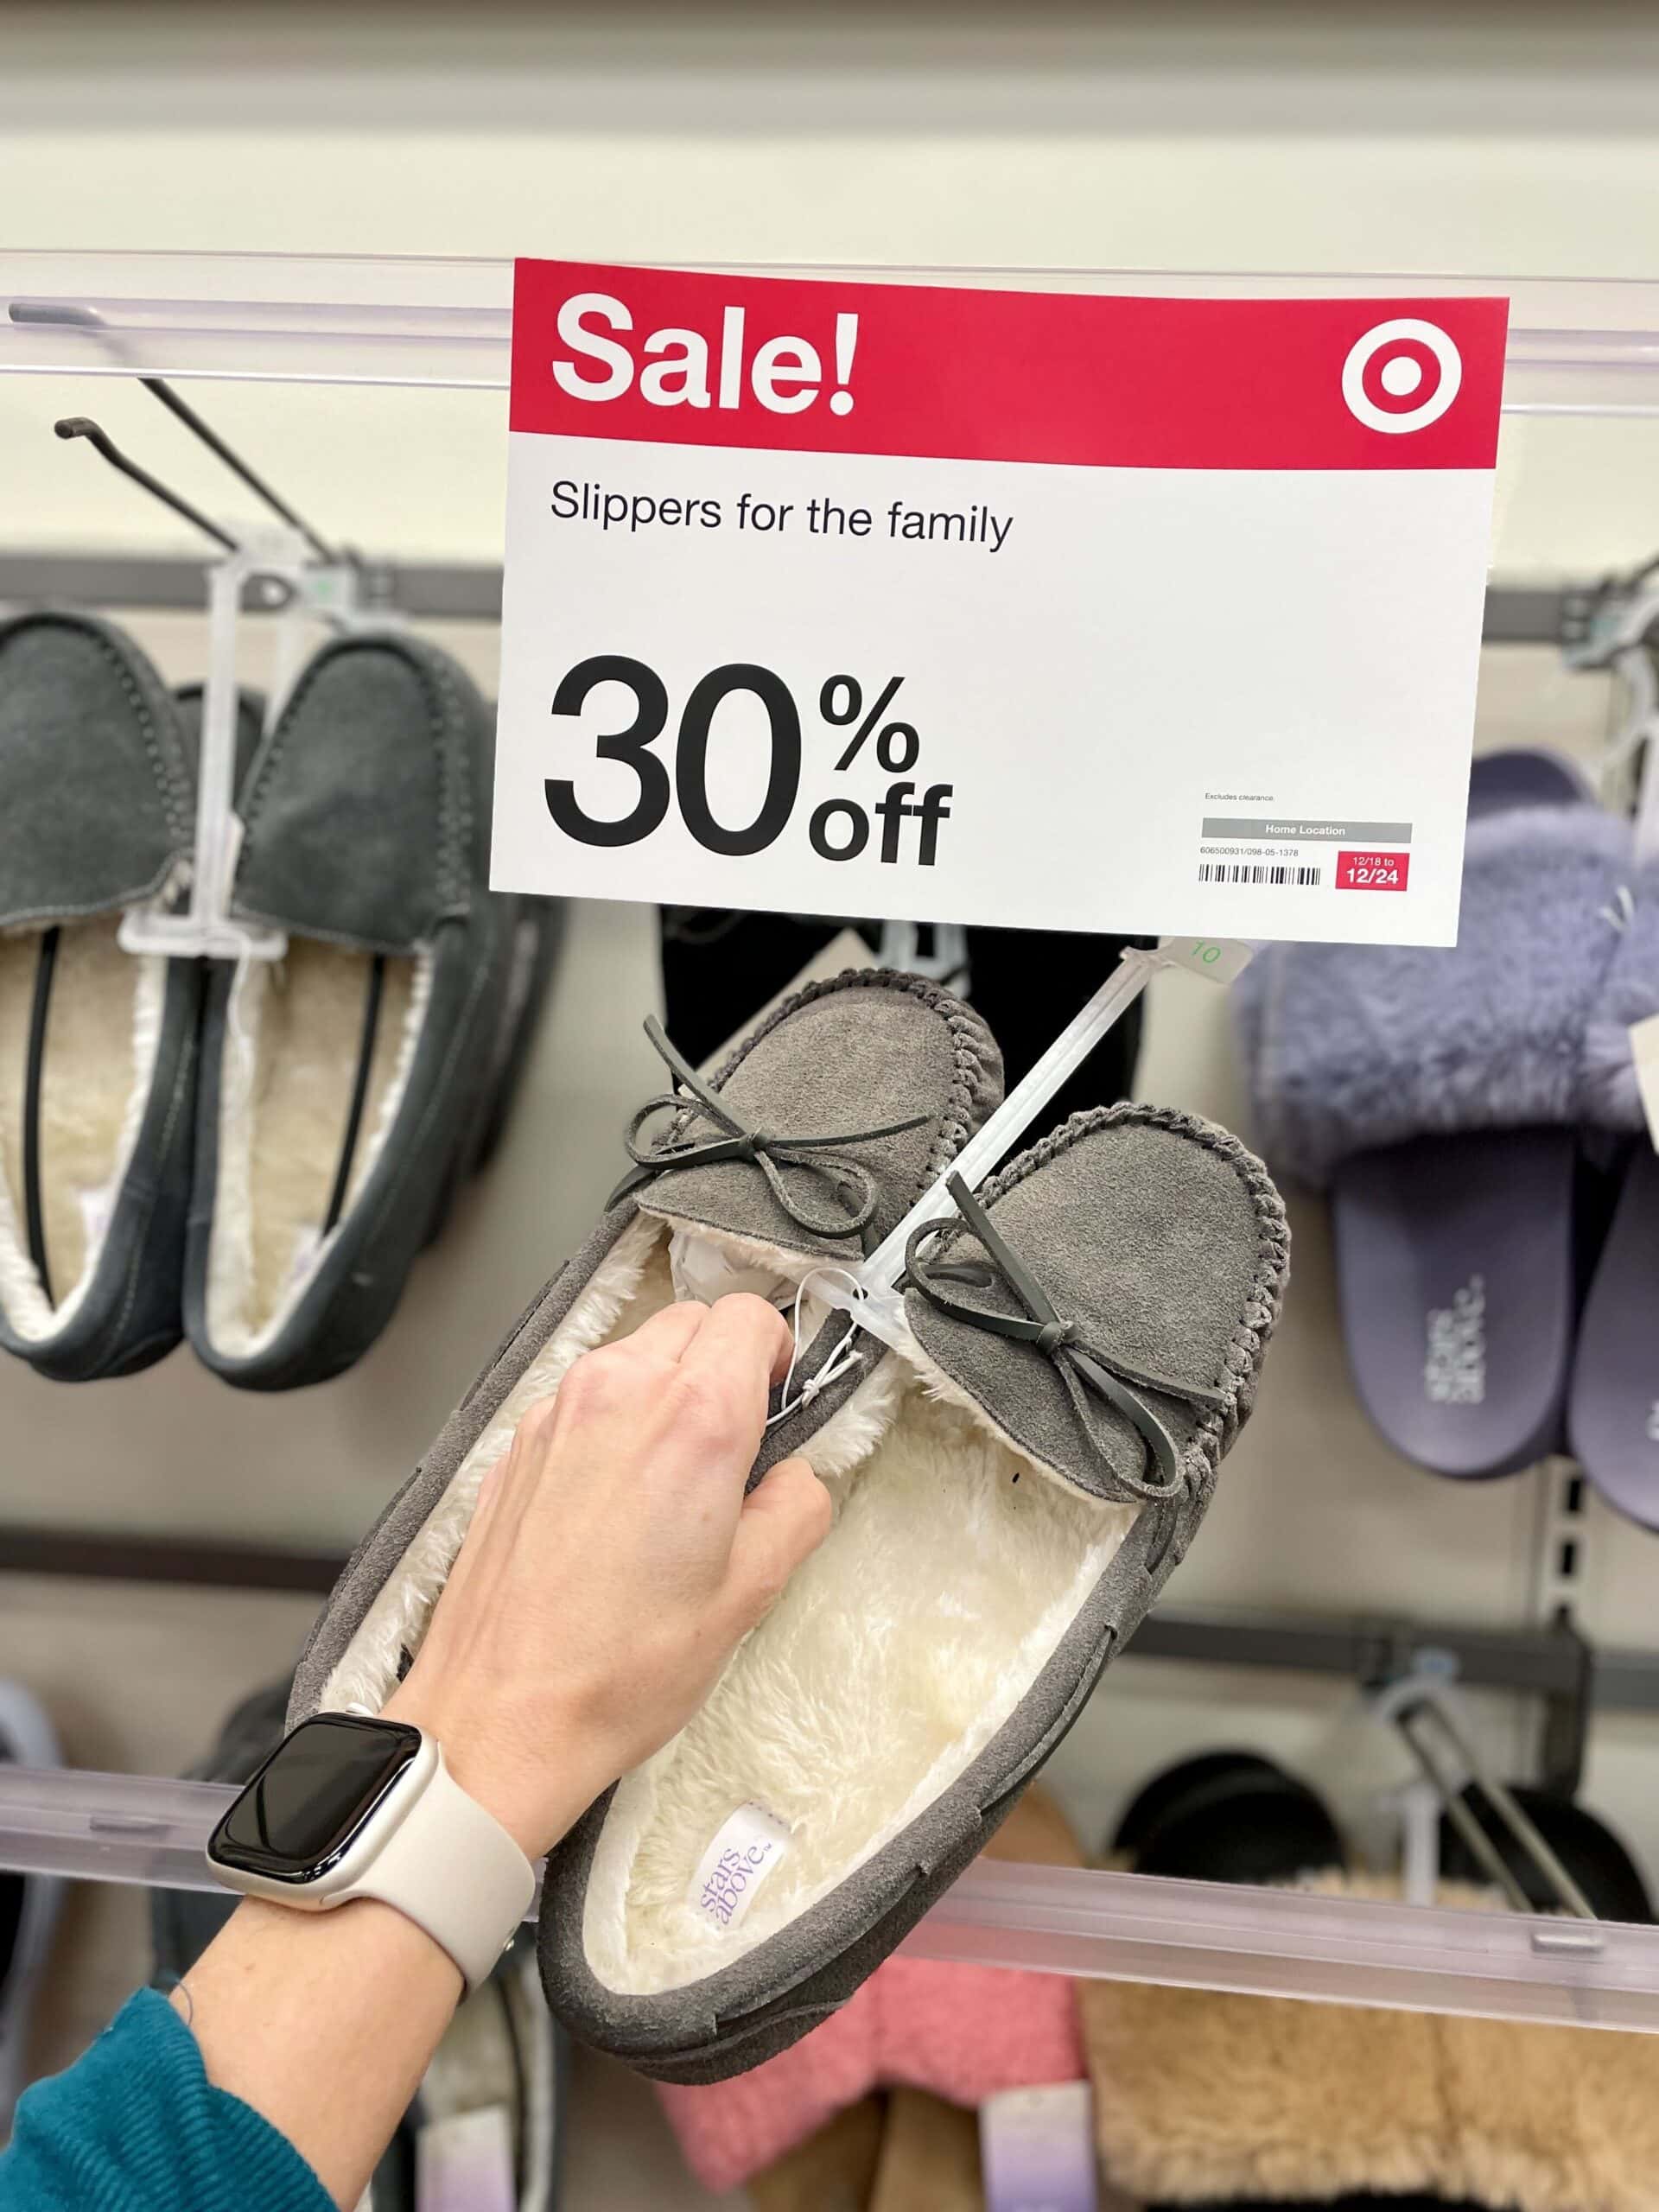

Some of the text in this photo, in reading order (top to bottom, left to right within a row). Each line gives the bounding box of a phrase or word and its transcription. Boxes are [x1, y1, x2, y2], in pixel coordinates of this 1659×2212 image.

[553, 294, 859, 416] Sale!
[550, 480, 1014, 553] Slippers for the family
[1205, 792, 1237, 801] Excludes
[809, 781, 954, 867] off
[1265, 824, 1346, 836] Home Location
[1353, 856, 1395, 867] 12/18 to
[1347, 868, 1399, 885] 12/24
[1191, 940, 1222, 963] 10
[700, 1847, 741, 1912] stars
